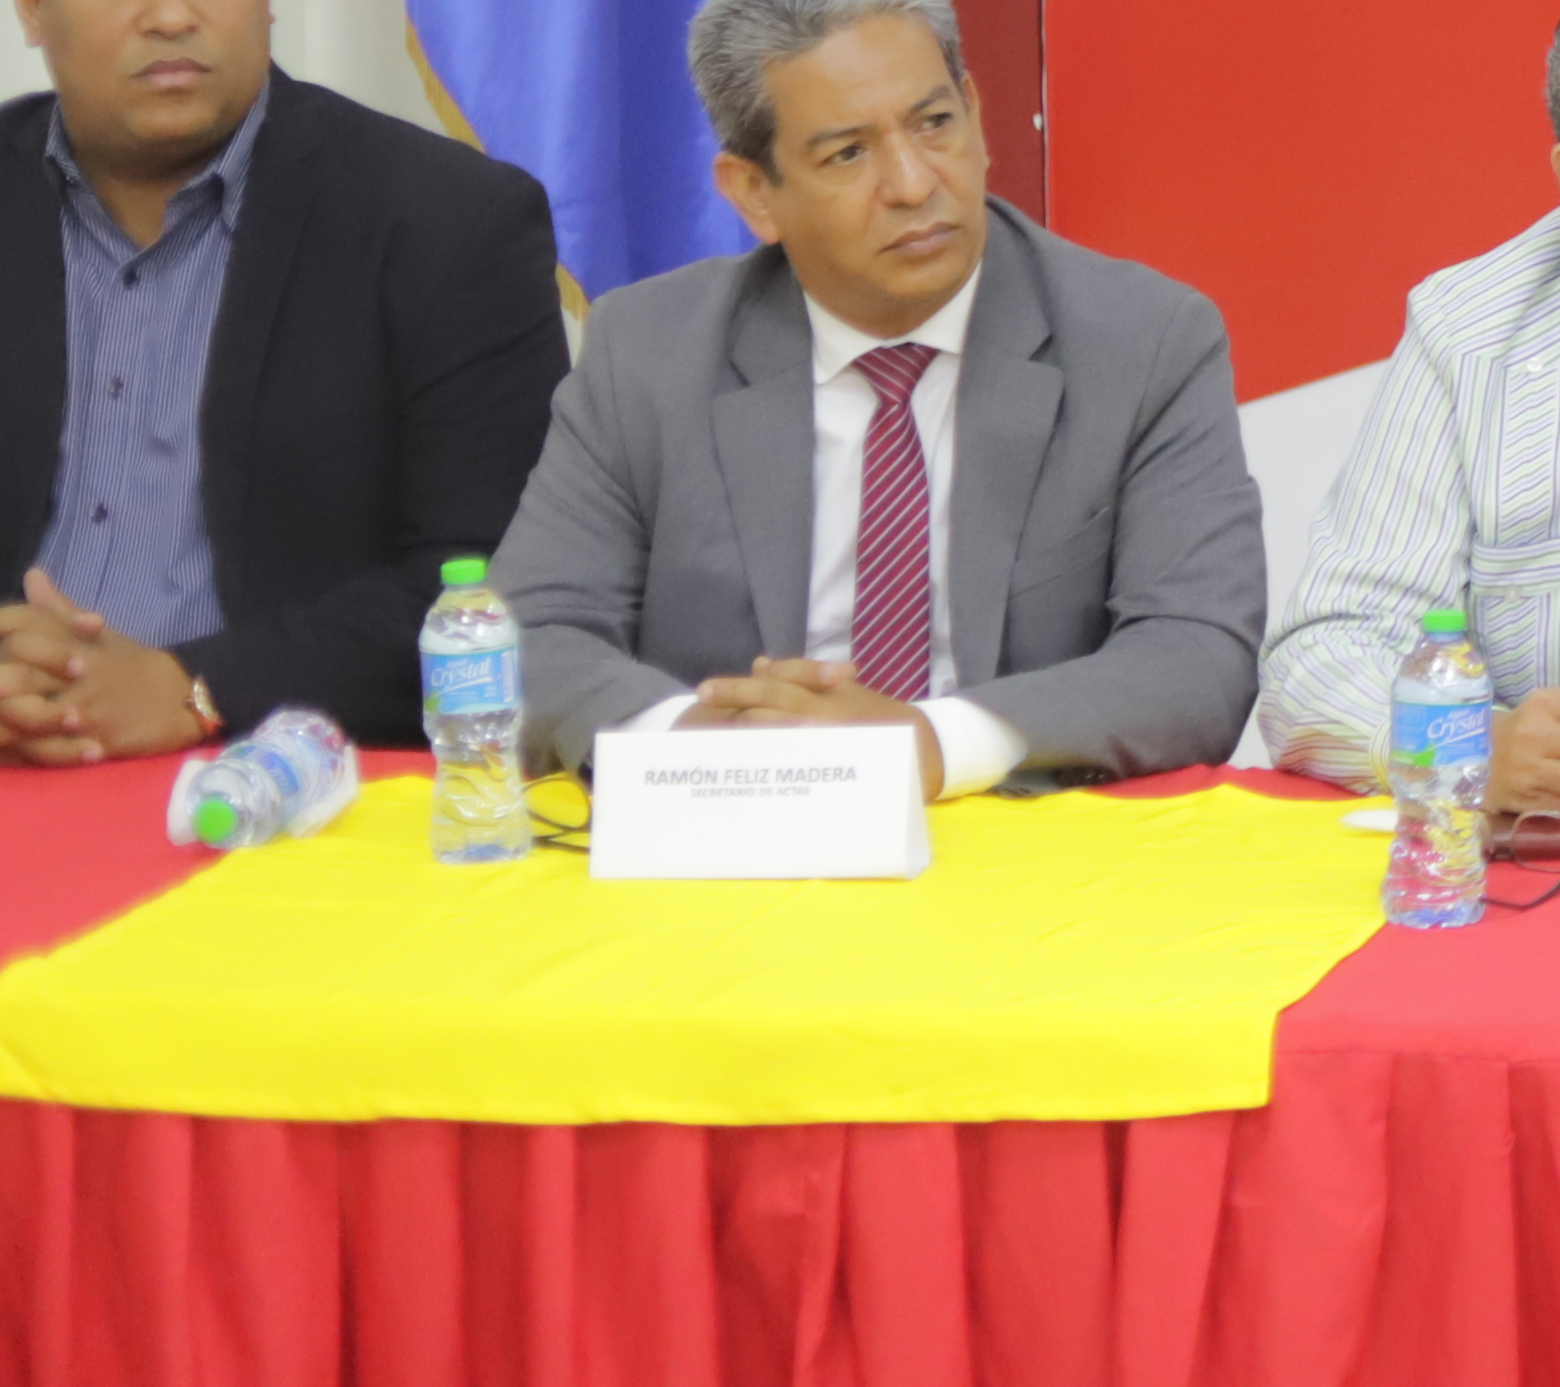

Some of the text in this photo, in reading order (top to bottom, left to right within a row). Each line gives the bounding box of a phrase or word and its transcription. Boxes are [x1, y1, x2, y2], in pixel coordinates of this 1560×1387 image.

[644, 766, 857, 786] RAMÓN FELIZ MADERA
[690, 785, 811, 798] SECRETARIO DE ACTAS
